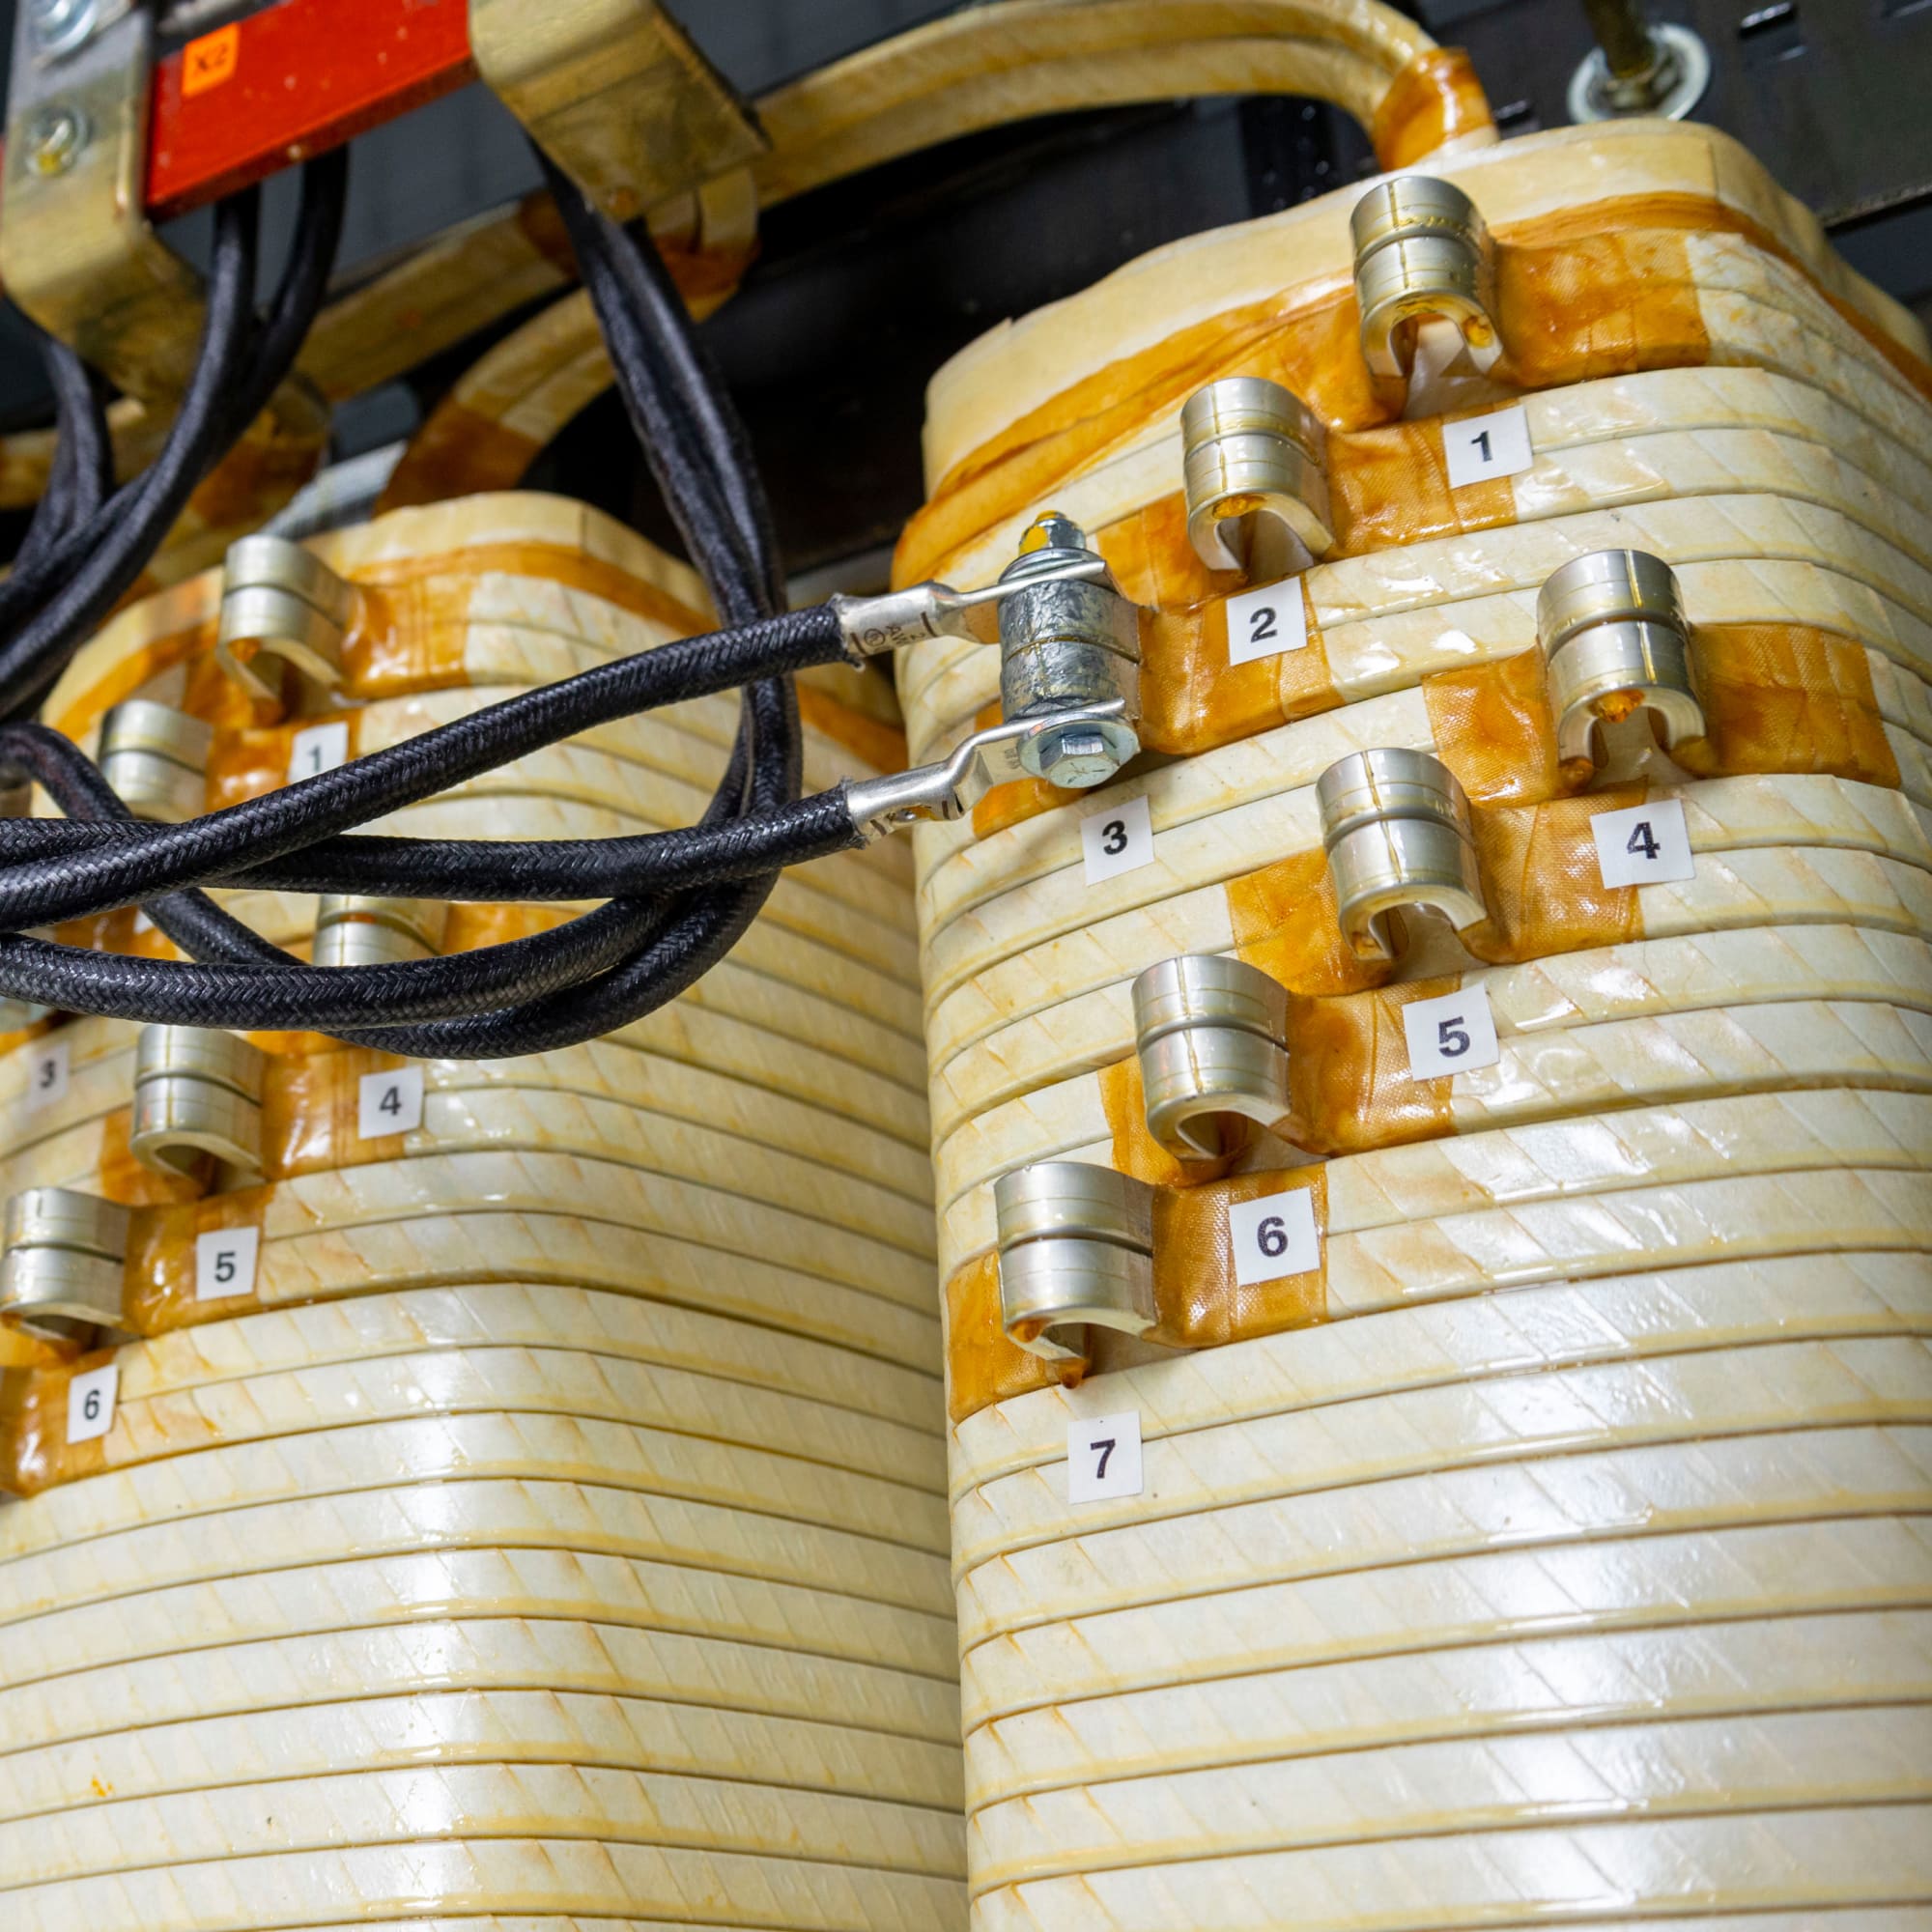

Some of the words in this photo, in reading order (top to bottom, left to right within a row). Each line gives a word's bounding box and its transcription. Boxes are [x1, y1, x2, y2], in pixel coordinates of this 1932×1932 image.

[1471, 431, 1492, 462] 1
[1250, 608, 1277, 642] 2
[308, 744, 322, 774] 1
[1102, 819, 1127, 855] 3
[1628, 822, 1661, 859] 4
[1438, 1016, 1470, 1057] 5
[40, 1060, 56, 1090] 3
[379, 1087, 402, 1116] 4
[1258, 1217, 1288, 1257] 6
[215, 1251, 236, 1283] 5
[84, 1389, 100, 1420] 6
[1091, 1438, 1116, 1479] 7
